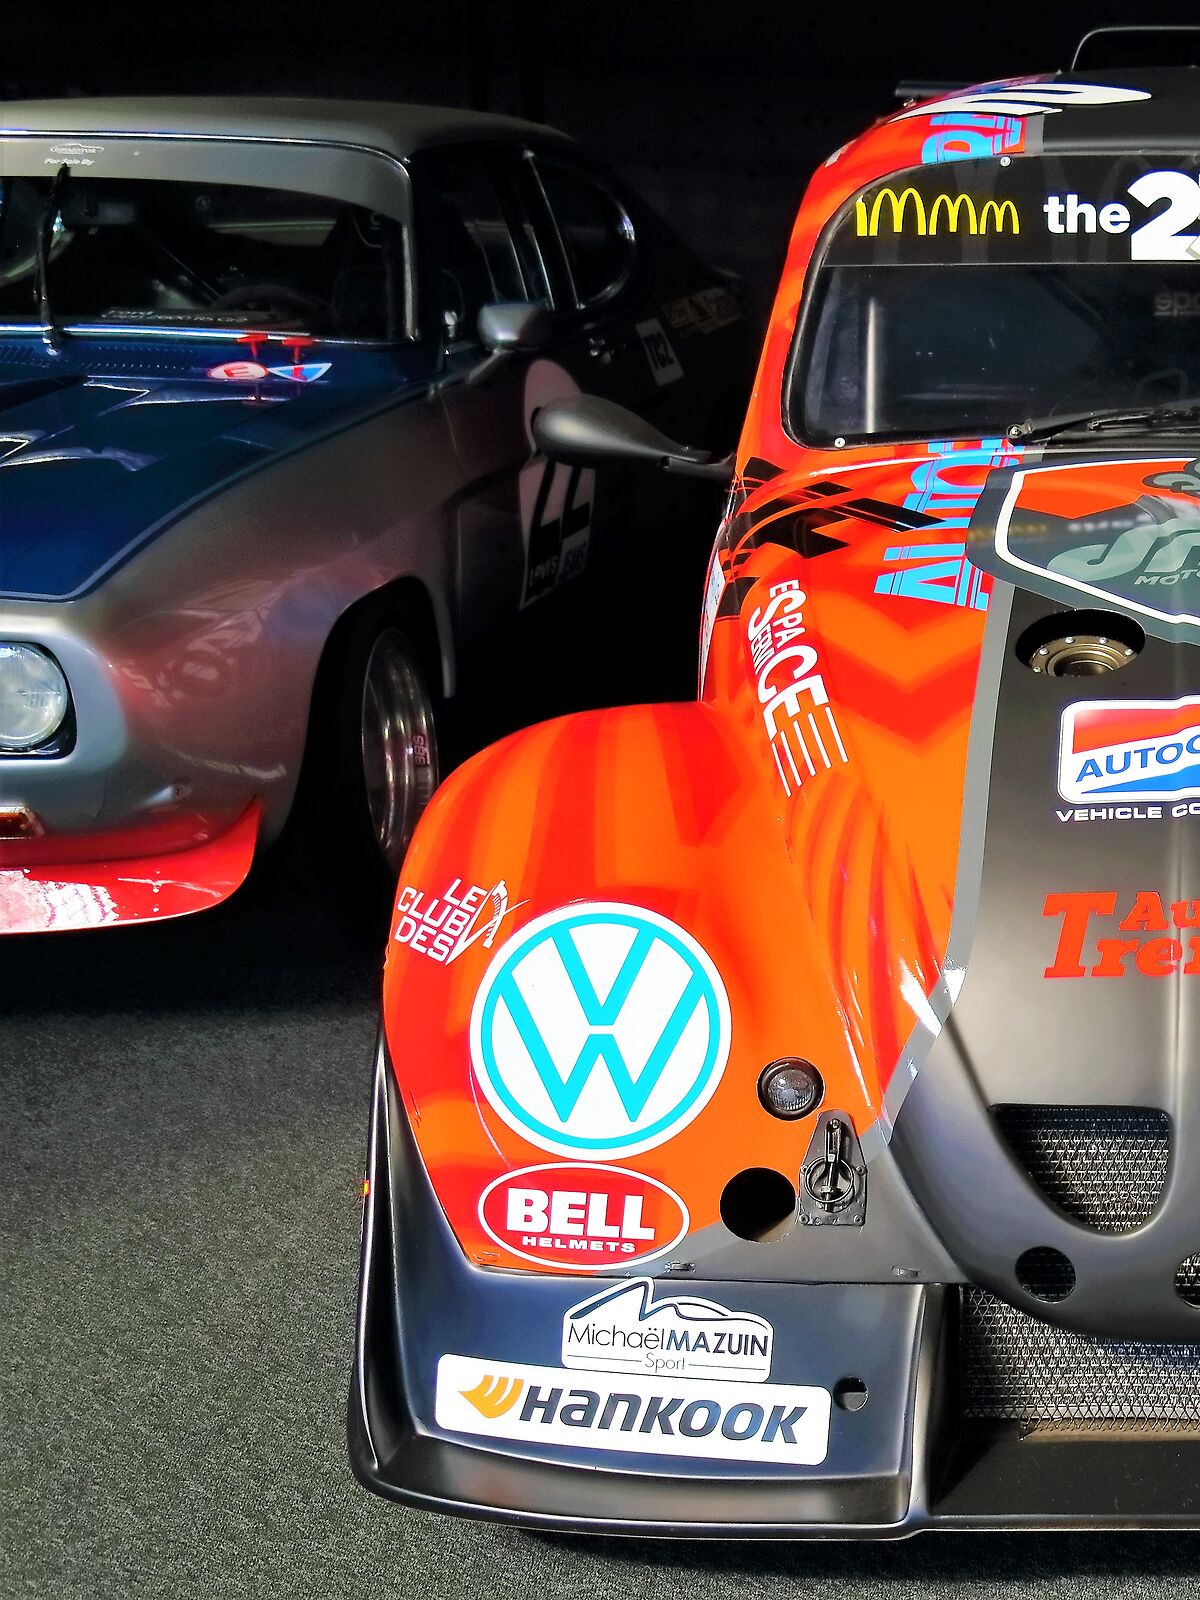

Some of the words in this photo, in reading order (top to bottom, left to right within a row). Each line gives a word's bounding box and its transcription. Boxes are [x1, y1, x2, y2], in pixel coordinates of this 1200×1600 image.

[1043, 194, 1131, 234] the
[1056, 806, 1163, 822] VEHICLE
[397, 886, 470, 937] CLUB
[443, 878, 488, 913] LE
[394, 914, 455, 962] DES
[506, 1187, 655, 1241] BELL
[522, 1236, 636, 1254] HELMETS
[645, 1352, 685, 1373] Sport
